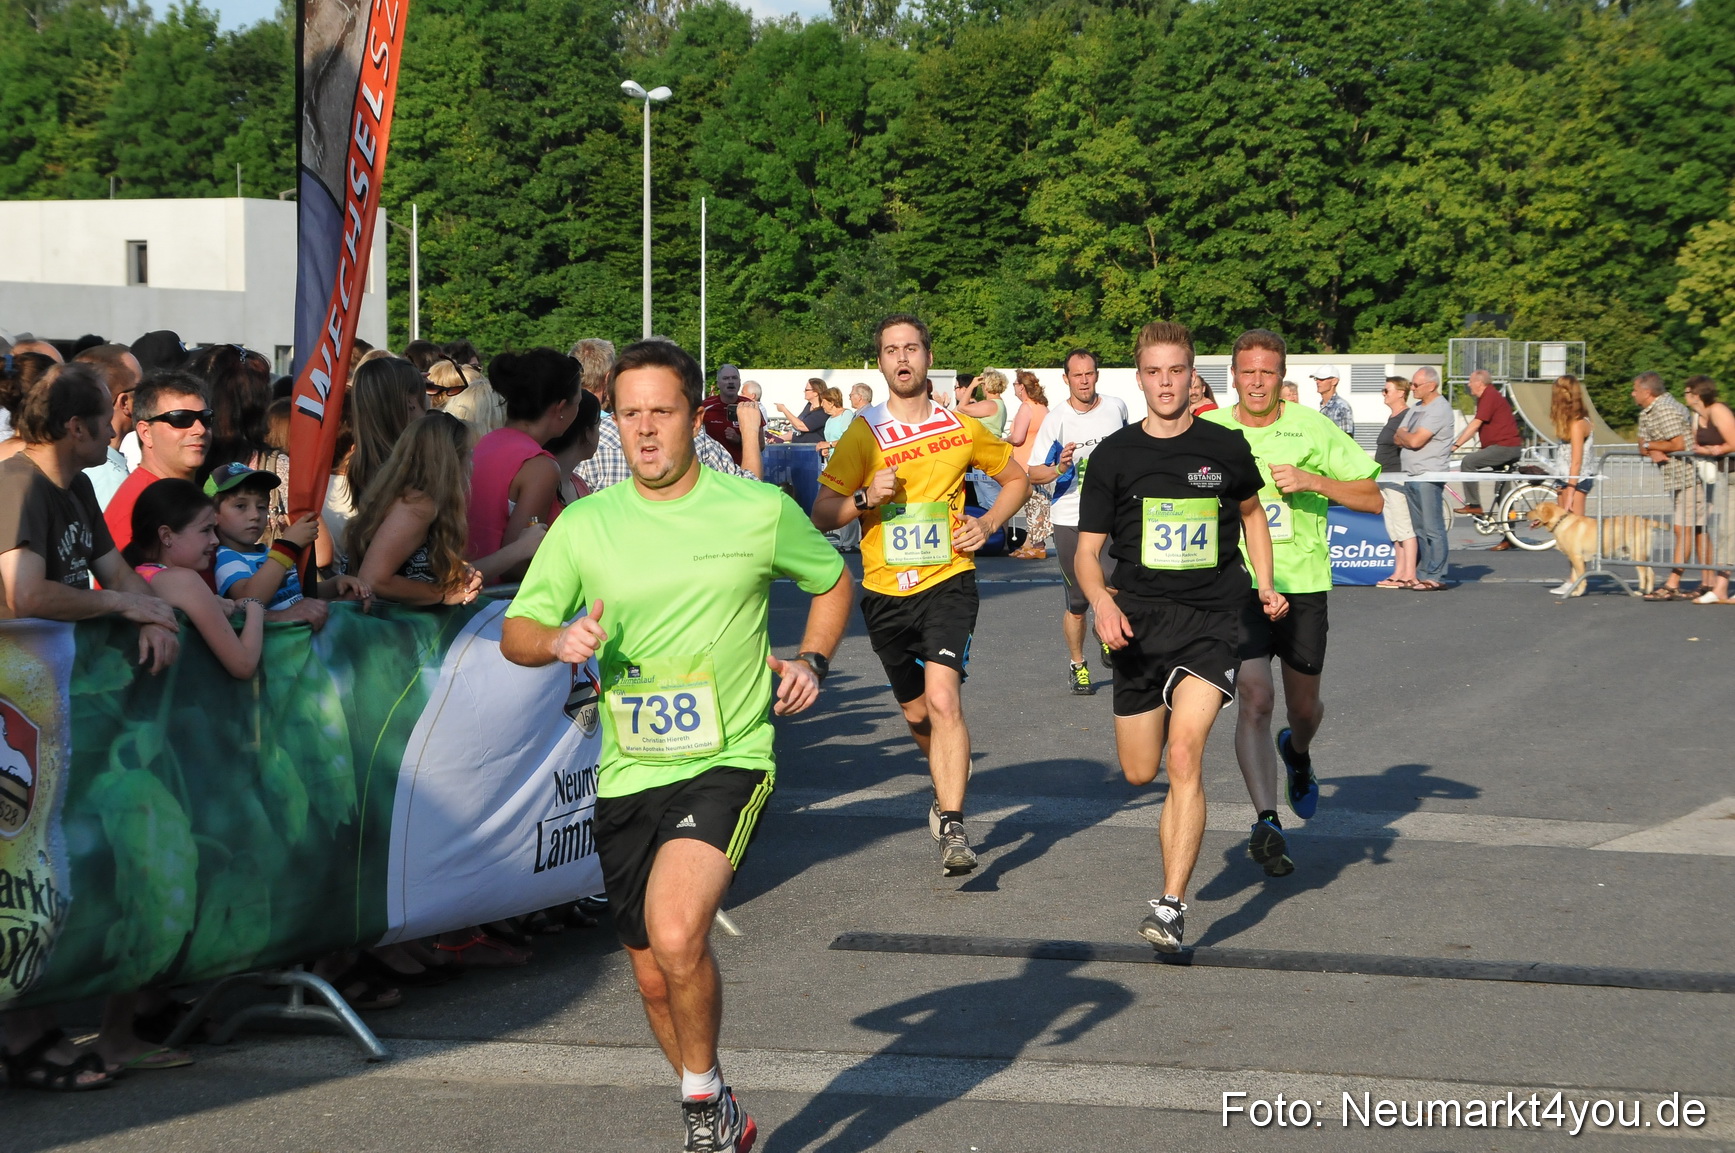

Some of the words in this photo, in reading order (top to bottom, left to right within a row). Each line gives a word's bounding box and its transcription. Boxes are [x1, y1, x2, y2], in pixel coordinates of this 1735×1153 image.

[884, 446, 924, 468] MAX
[928, 433, 973, 454] BÖGL
[892, 524, 941, 551] 814
[1154, 523, 1208, 551] 314
[693, 551, 754, 562] Dorfner-Apotheken
[621, 692, 702, 735] 738
[666, 743, 693, 751] Neumarkt
[667, 735, 690, 743] Hiereth
